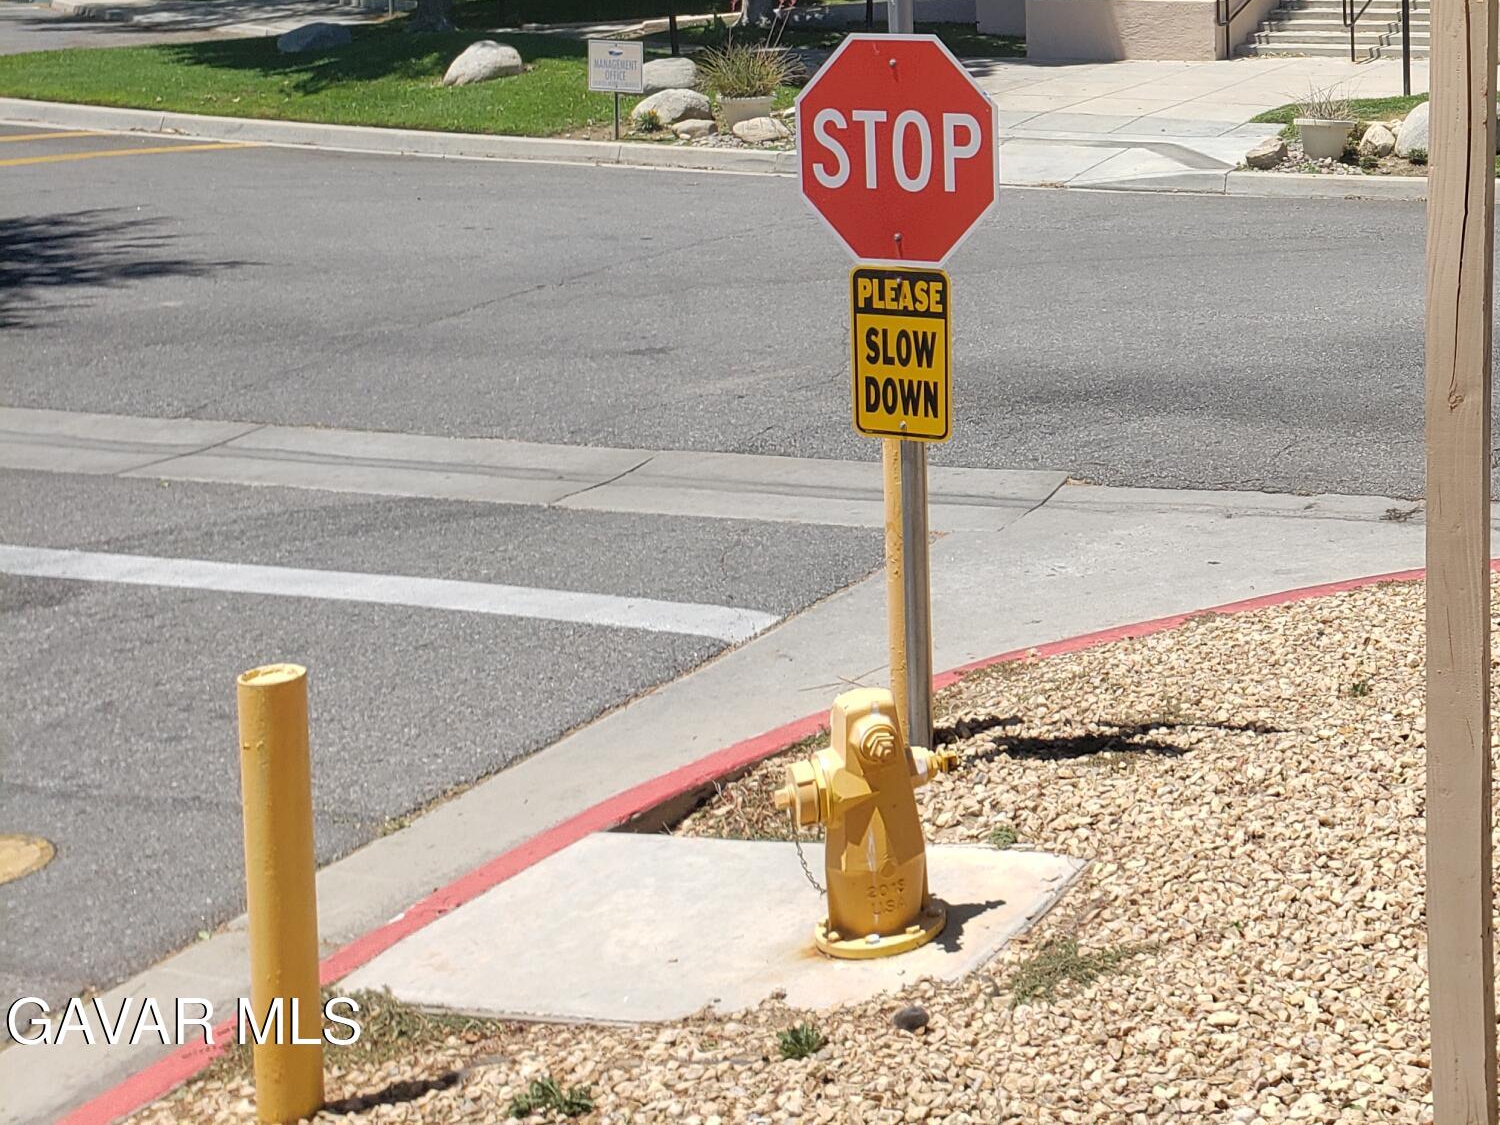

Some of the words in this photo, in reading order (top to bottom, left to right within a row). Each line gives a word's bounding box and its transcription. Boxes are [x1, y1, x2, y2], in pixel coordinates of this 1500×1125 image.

[594, 58, 638, 71] MANAGEMENT
[605, 70, 626, 81] OFFICE
[812, 108, 982, 192] STOP
[857, 277, 943, 312] PLEASE
[865, 326, 937, 368] SLOW
[865, 375, 939, 419] DOWN
